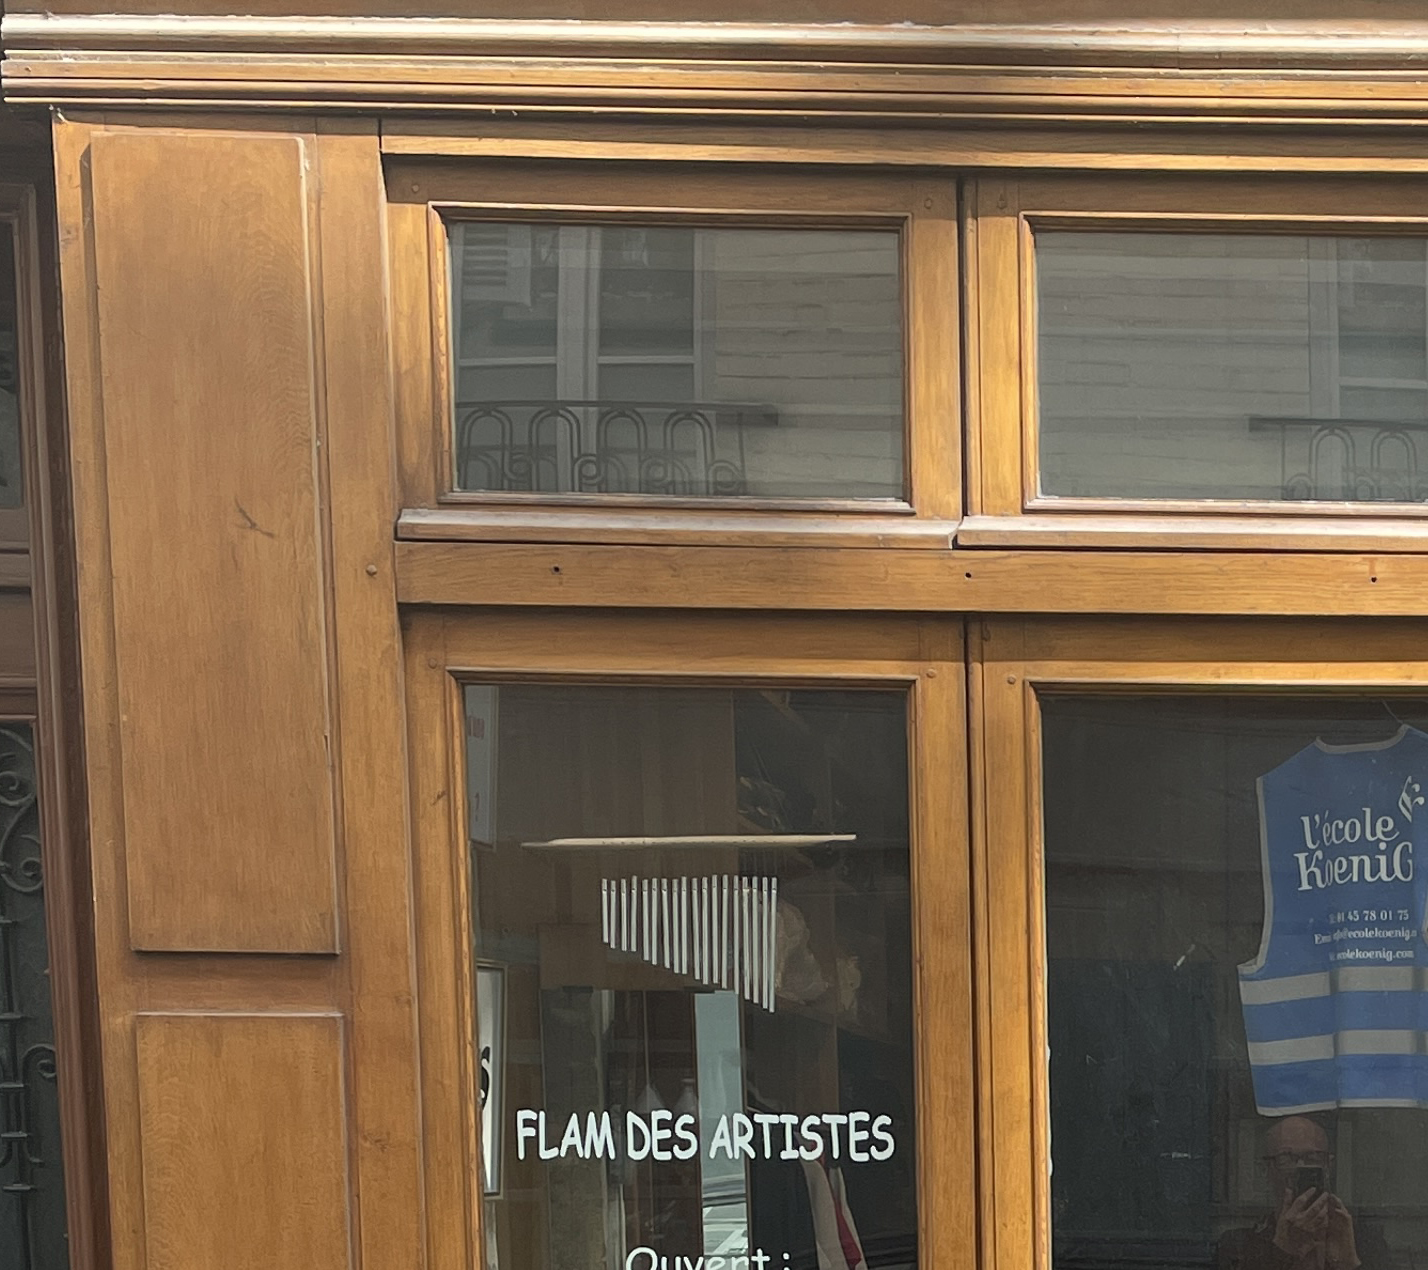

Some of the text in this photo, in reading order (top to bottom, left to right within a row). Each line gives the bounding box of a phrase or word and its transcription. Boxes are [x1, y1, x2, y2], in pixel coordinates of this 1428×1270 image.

[1347, 909, 1359, 922] 45
[1362, 909, 1377, 921] 78
[1380, 909, 1393, 921] 01
[1397, 908, 1410, 921] 75
[516, 1109, 895, 1162] FLAM DES ARTISTES
